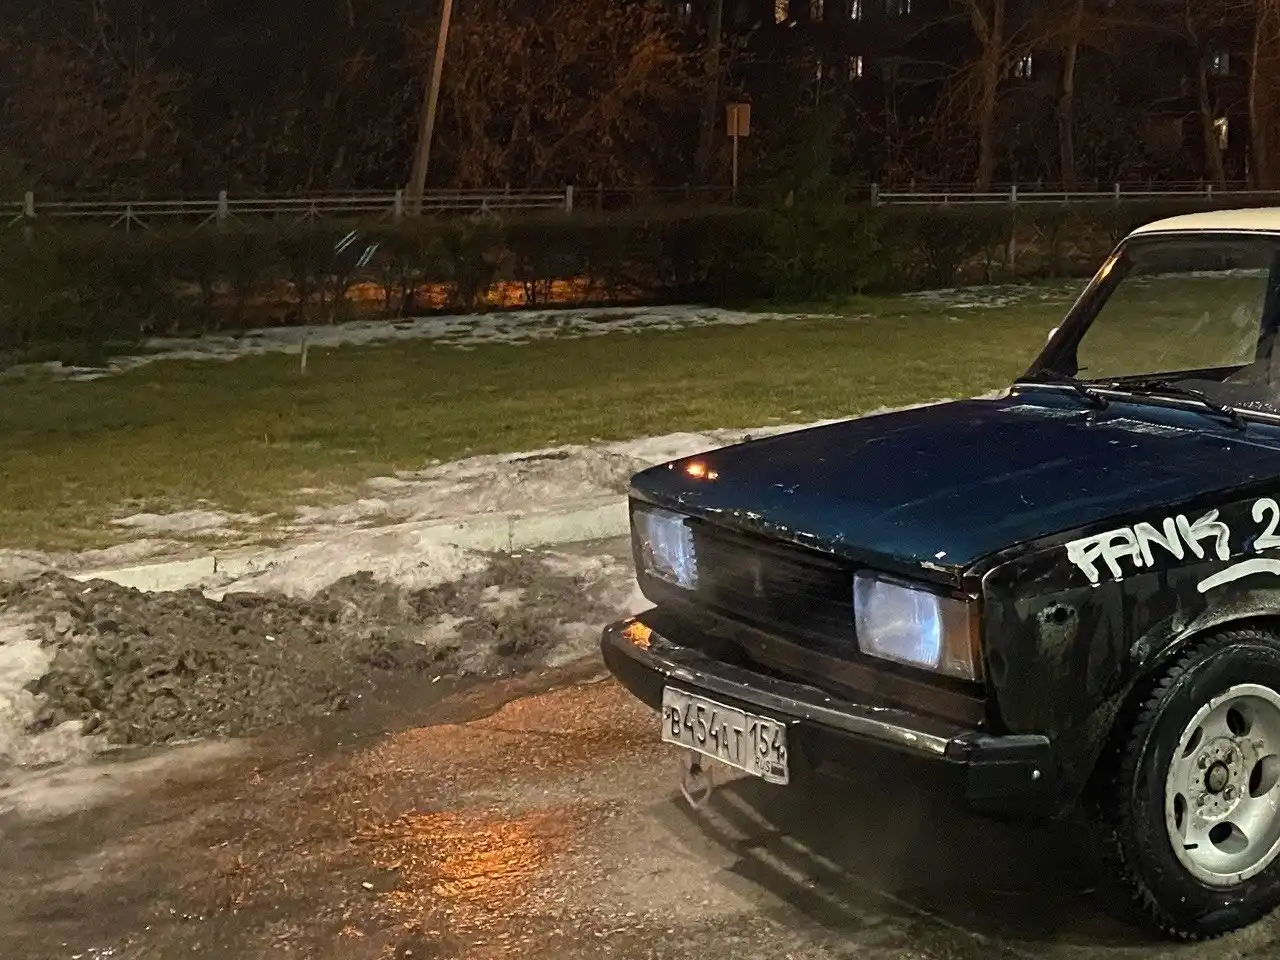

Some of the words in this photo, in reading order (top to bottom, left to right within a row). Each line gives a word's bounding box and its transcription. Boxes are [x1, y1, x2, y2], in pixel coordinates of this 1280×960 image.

[1065, 509, 1231, 586] PANK
[748, 721, 784, 763] 154
[754, 756, 772, 773] RUS
